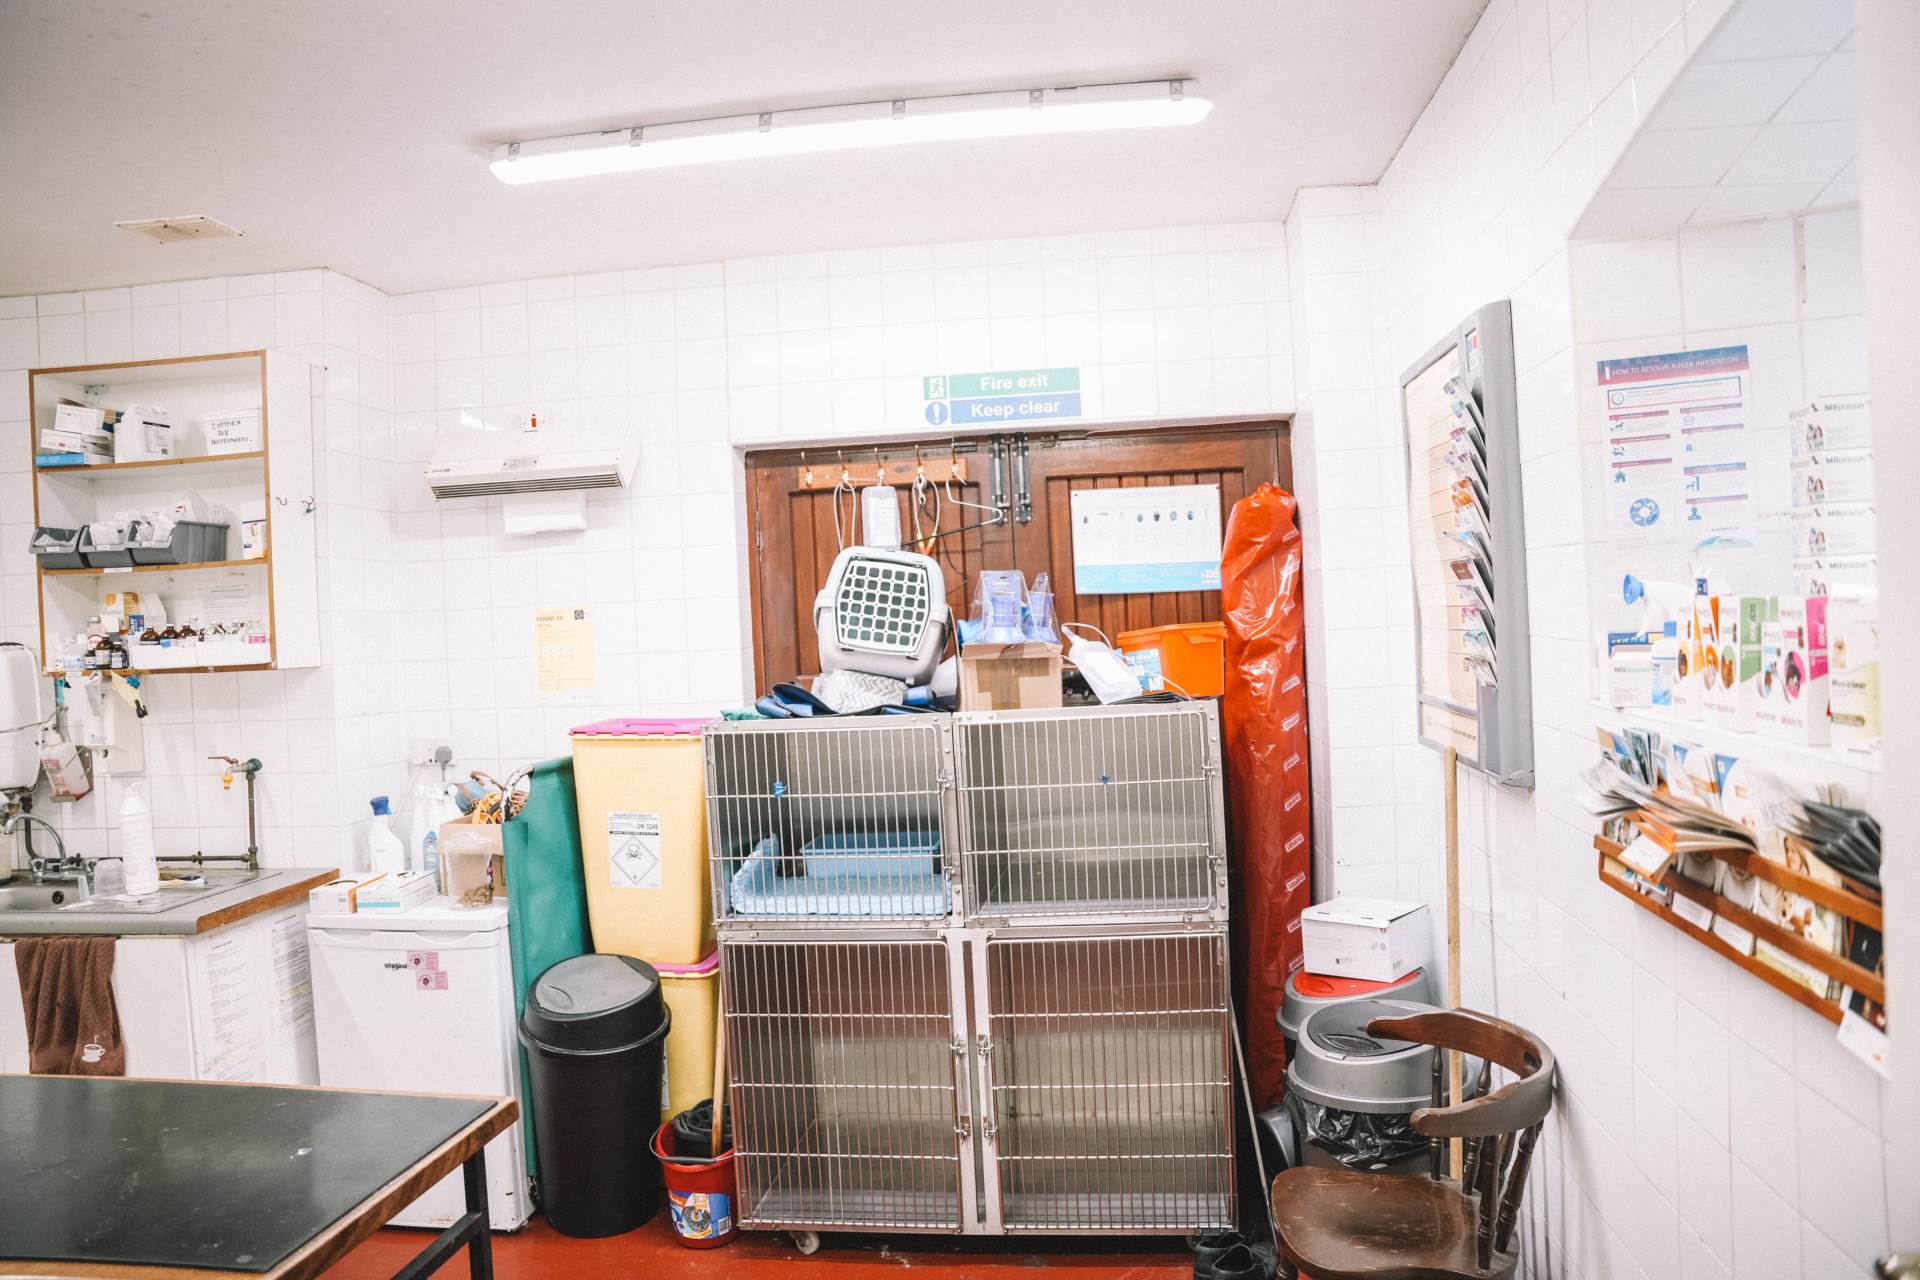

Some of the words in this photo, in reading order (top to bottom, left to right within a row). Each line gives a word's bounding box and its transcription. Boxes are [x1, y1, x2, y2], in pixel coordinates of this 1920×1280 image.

[1630, 367, 1640, 375] TO
[1641, 365, 1670, 373] RESOLVE
[1677, 361, 1693, 369] FLEA
[1695, 356, 1740, 367] INFESTATION
[980, 376, 1013, 391] Fire
[1017, 374, 1048, 388] exit
[971, 402, 1014, 419] Keep
[1019, 400, 1061, 415] clear
